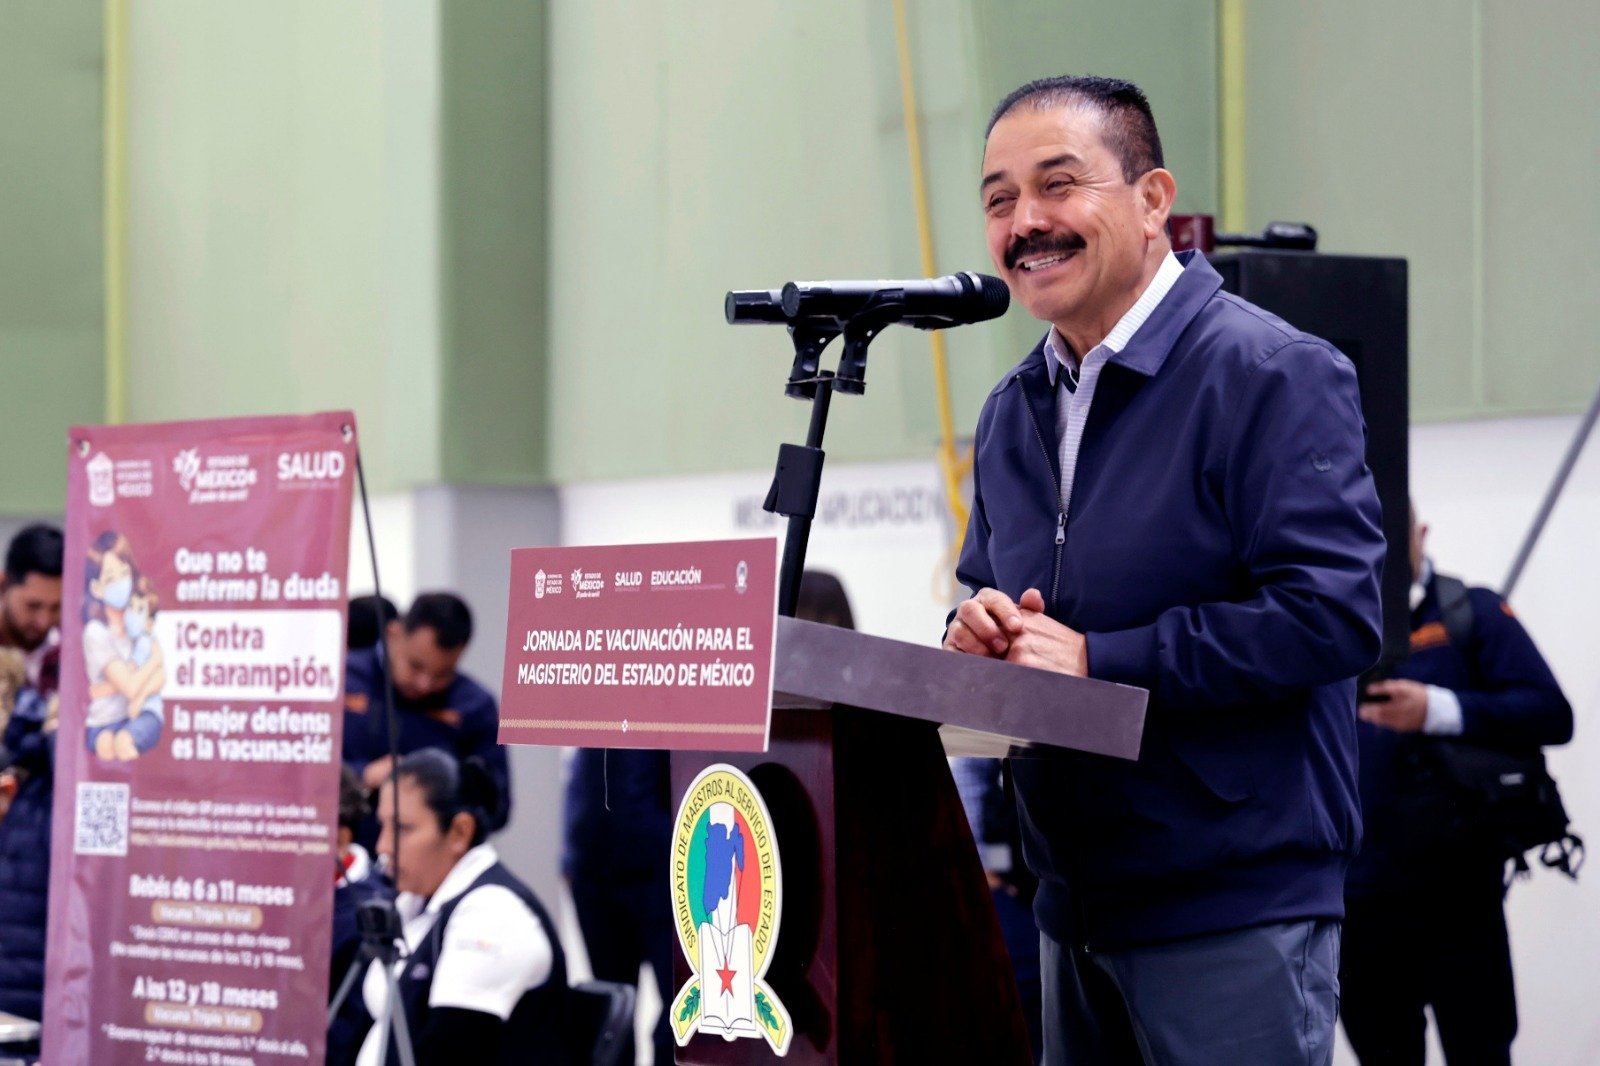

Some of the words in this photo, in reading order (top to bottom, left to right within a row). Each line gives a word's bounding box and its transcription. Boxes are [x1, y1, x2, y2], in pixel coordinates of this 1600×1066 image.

[277, 451, 345, 480] SALUD
[175, 548, 213, 574] Que
[216, 551, 243, 574] no
[246, 547, 267, 573] te
[176, 574, 257, 601] enferme
[260, 573, 280, 600] la
[284, 572, 339, 600] duda
[615, 571, 642, 586] SALUD
[651, 566, 701, 585] EDUCACIÓN
[176, 622, 264, 650] ¡Contra
[523, 630, 582, 652] JORNADA
[585, 629, 602, 650] DE
[606, 623, 692, 650] VACUNACIÓN
[696, 628, 733, 650] PARA
[736, 627, 753, 650] EL
[177, 657, 195, 686] el
[517, 663, 592, 685] MAGISTERIO
[594, 664, 618, 685] DEL
[622, 663, 676, 686] ESTADO
[678, 663, 697, 686] DE
[699, 657, 755, 687] MÉXICO
[173, 704, 190, 732] la
[193, 705, 248, 738] mejor
[172, 737, 193, 760] es
[196, 733, 213, 760] la
[683, 778, 723, 829] MAESTROS
[725, 780, 736, 800] AL
[737, 787, 766, 848] SERVICIO
[677, 835, 689, 856] DE
[761, 852, 772, 883] DEL
[129, 874, 171, 898] Bebés
[172, 876, 191, 900] de
[193, 878, 205, 901] 6
[206, 882, 218, 902] a
[219, 880, 235, 902] 11
[236, 884, 294, 906] meses
[676, 860, 696, 949] SINDICATO
[756, 889, 773, 955] ESTADO
[132, 976, 145, 999] A
[146, 977, 166, 1001] los
[167, 978, 186, 1002] 12
[186, 984, 200, 1007] y
[201, 981, 220, 1005] 18
[222, 986, 279, 1010] meses
